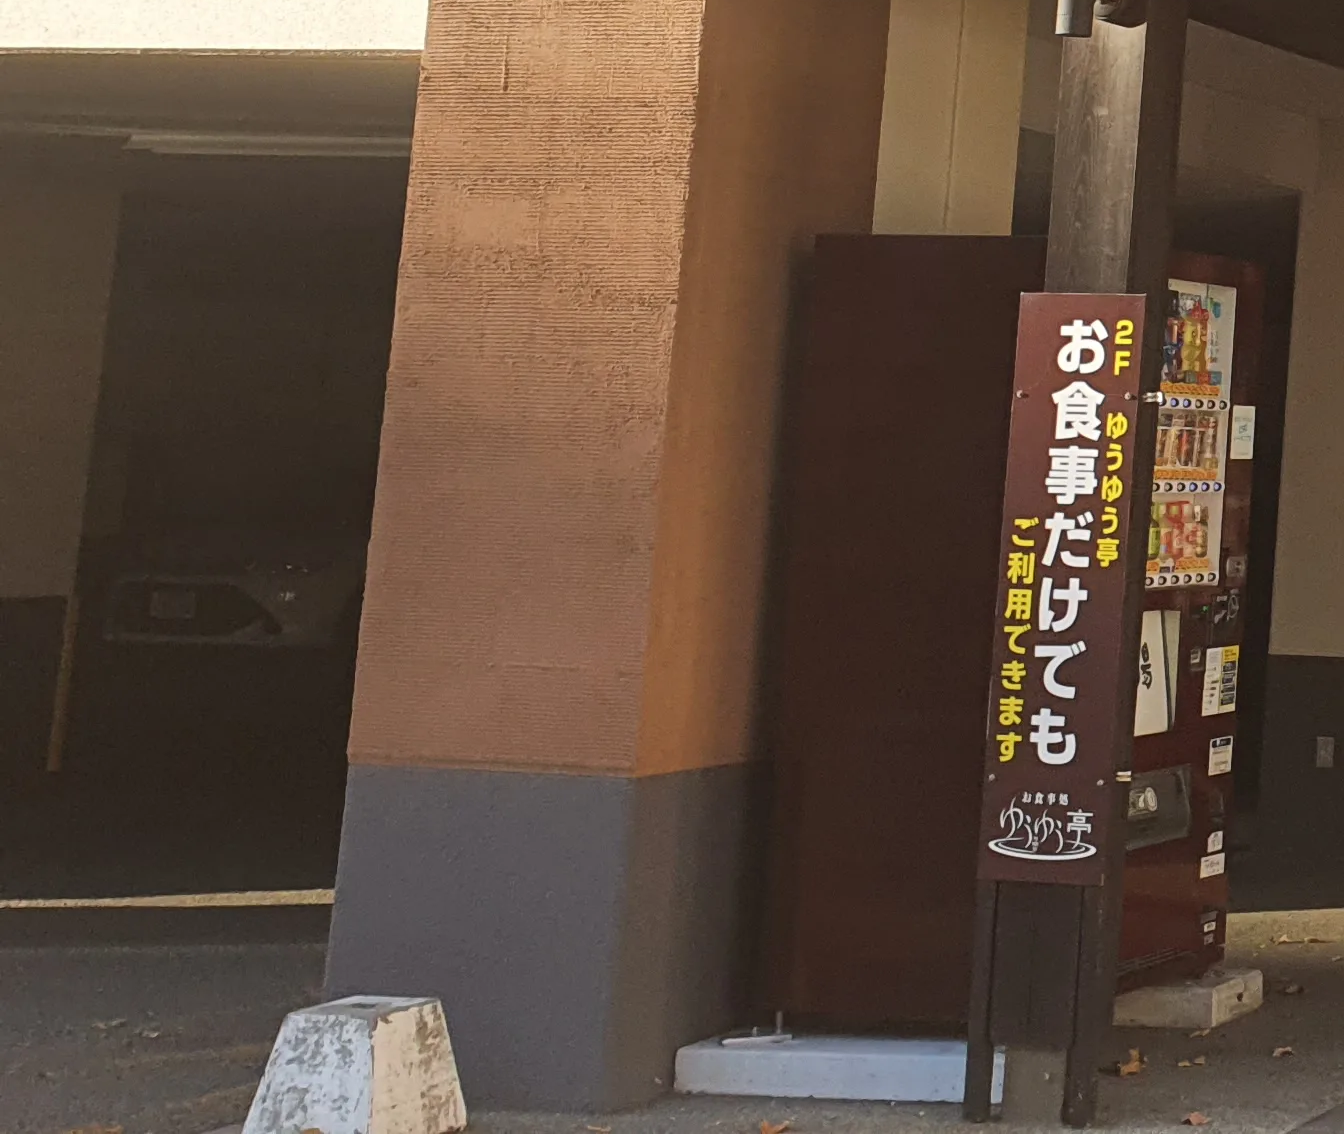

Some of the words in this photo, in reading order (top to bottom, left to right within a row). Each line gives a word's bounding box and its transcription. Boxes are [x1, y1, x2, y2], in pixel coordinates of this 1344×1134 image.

[1112, 319, 1135, 377] 2F
[1028, 318, 1109, 767] お食事だけでも
[1096, 412, 1129, 568] ゆうゆう亭
[995, 517, 1039, 763] ご利用できます
[999, 795, 1094, 854] ゆうゆう亭
[1021, 791, 1069, 806] お食事処
